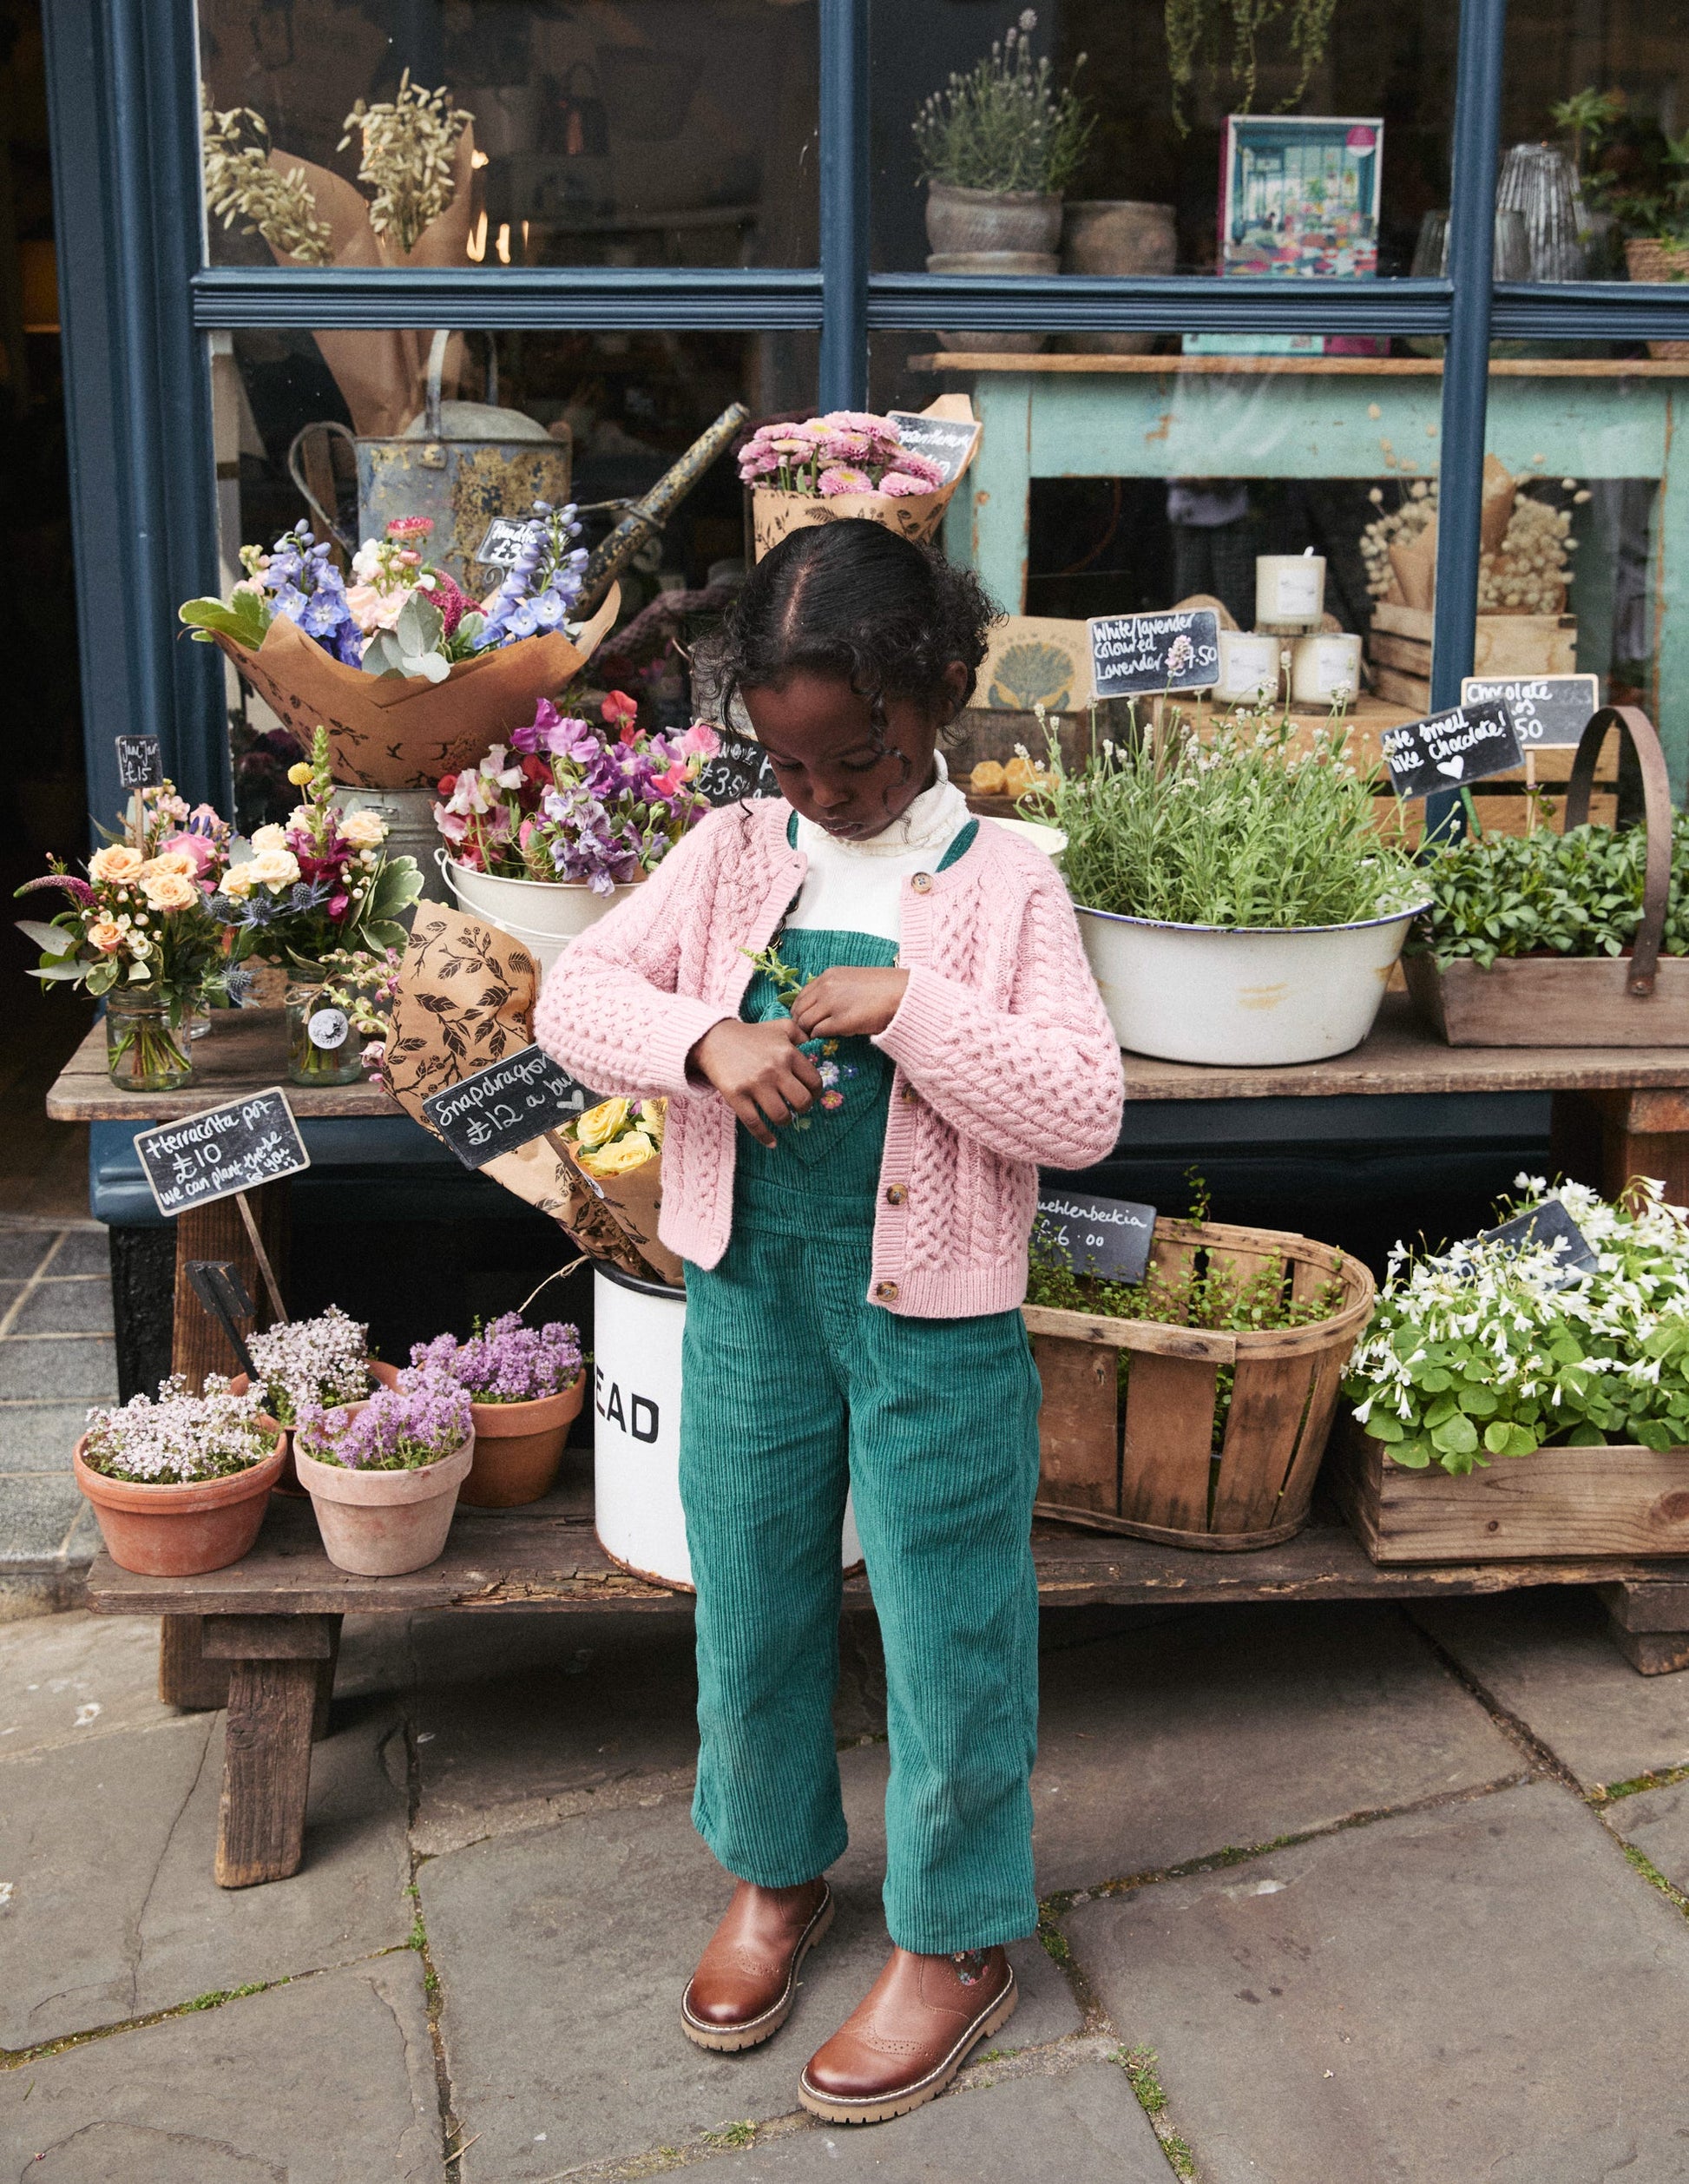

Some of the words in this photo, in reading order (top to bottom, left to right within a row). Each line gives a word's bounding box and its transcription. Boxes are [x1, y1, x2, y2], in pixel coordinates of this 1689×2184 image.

[1096, 652, 1164, 681] Lavender
[1418, 707, 1469, 743] smell
[125, 760, 152, 784] £15
[1390, 750, 1424, 773] like
[241, 1099, 274, 1131] pot
[465, 1103, 524, 1146] £12
[525, 1094, 546, 1108] a
[160, 1186, 185, 1206] we
[185, 1178, 210, 1196] can
[211, 1160, 244, 1190] plant
[242, 1130, 283, 1169] these
[172, 1142, 223, 1185] £10
[263, 1148, 290, 1172] you
